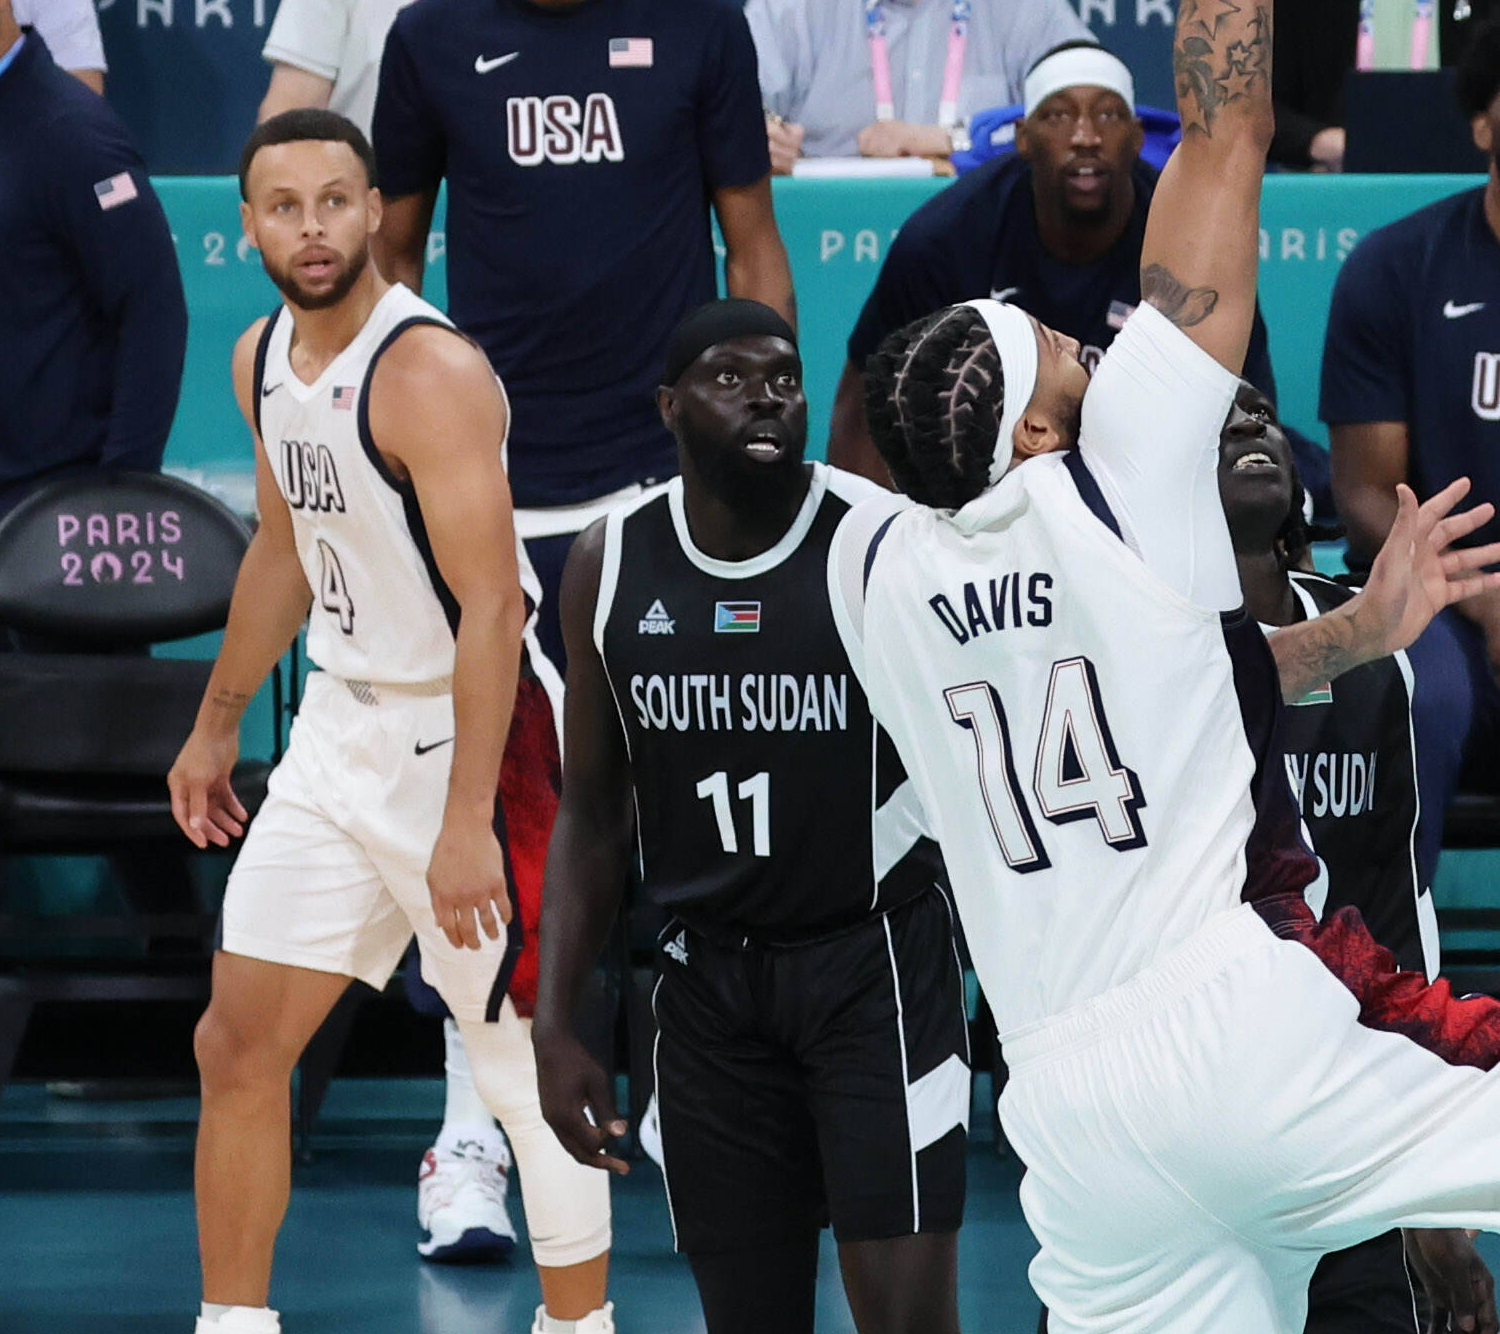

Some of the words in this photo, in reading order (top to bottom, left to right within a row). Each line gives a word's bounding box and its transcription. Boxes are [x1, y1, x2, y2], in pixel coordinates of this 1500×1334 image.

[505, 92, 625, 167] USA
[280, 439, 346, 513] USA
[61, 552, 184, 585] 2024
[318, 539, 355, 637] 4
[638, 620, 676, 634] PEAK
[929, 572, 1053, 645] DAVIS
[630, 673, 732, 731] SOUTH
[740, 673, 848, 731] SUDAN
[944, 656, 1148, 873] 14
[697, 771, 771, 857] 11
